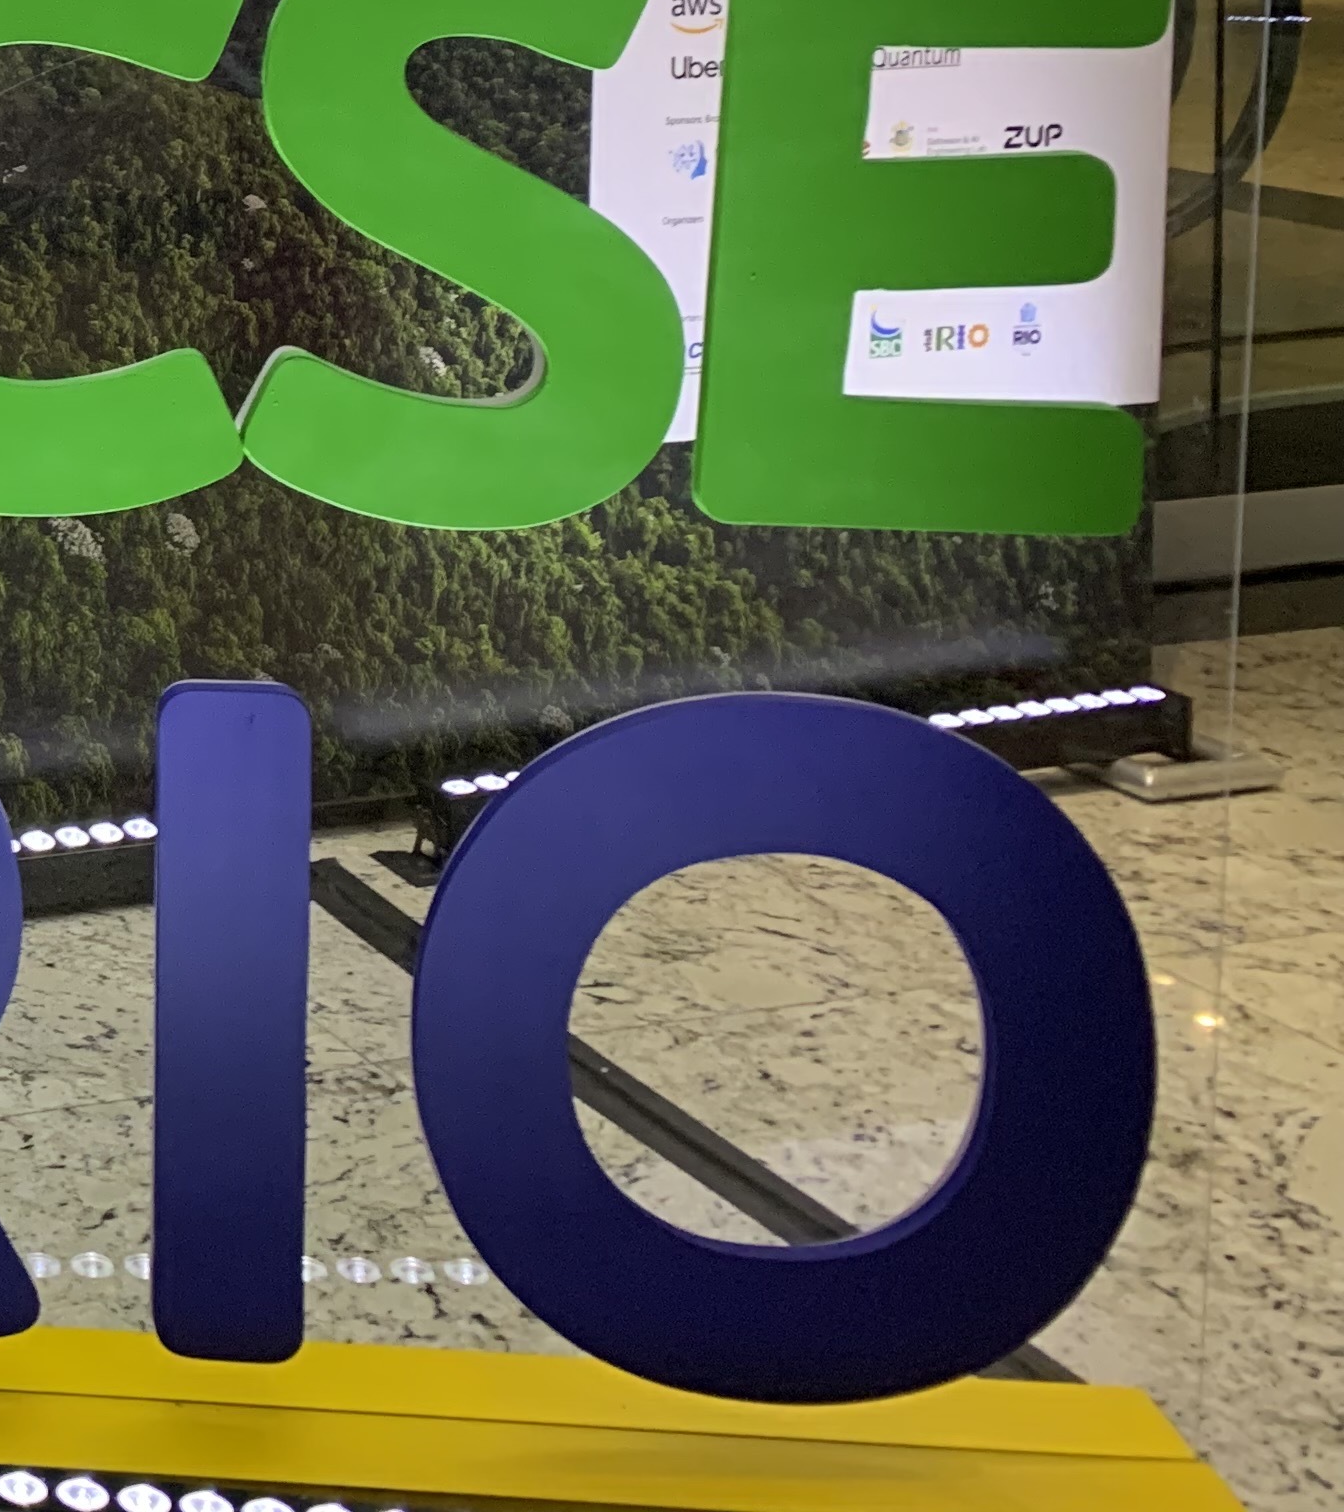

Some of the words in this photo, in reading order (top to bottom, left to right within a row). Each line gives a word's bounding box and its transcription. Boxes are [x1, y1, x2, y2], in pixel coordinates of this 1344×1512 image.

[872, 46, 961, 68] Quantum
[1003, 123, 1064, 148] ZUP
[935, 323, 990, 351] RIO
[1012, 329, 1042, 346] RIO
